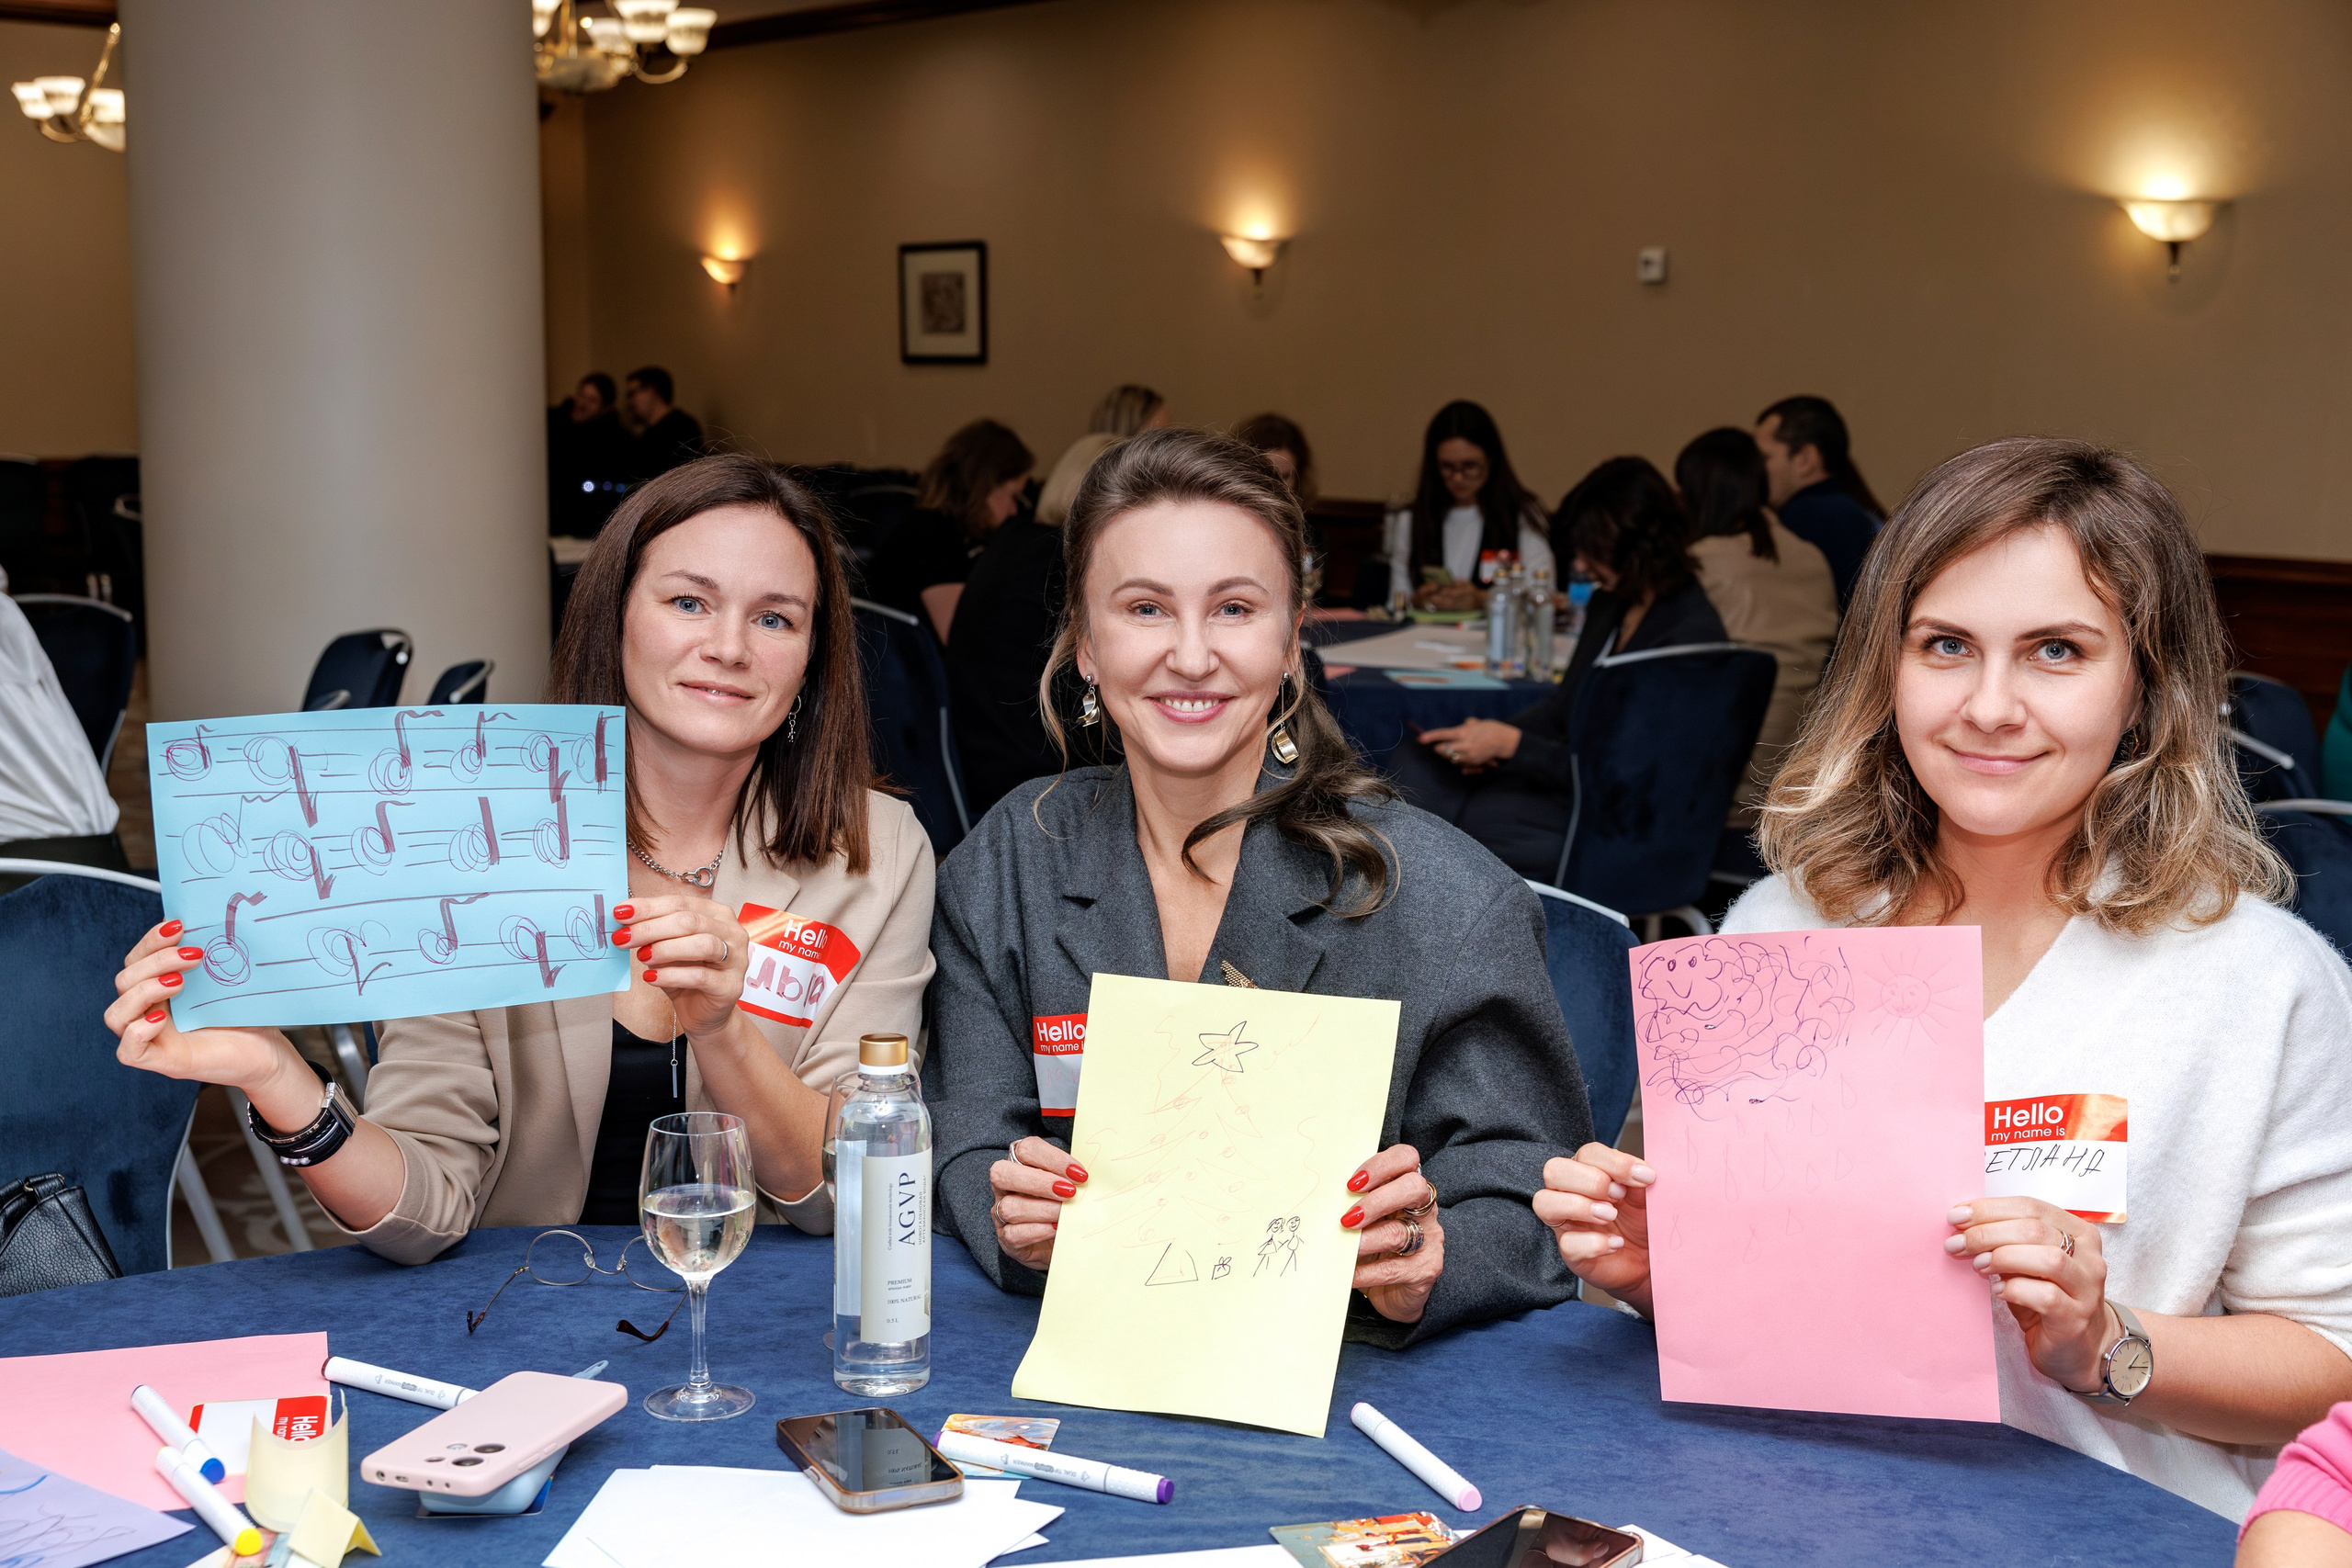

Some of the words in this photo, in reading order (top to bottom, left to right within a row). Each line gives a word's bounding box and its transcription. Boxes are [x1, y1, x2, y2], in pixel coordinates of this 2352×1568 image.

[784, 919, 828, 949] Hello
[778, 941, 797, 953] my
[1036, 1021, 1086, 1042] Hello
[1040, 1044, 1050, 1054] my
[1052, 1043, 1079, 1052] name
[1994, 1102, 2064, 1129] Hello
[1991, 1132, 2010, 1142] my
[2014, 1128, 2052, 1139] name
[2056, 1126, 2065, 1136] is
[899, 1172, 915, 1246] AGVP
[900, 1294, 922, 1303] NATURAL
[276, 1416, 288, 1425] my
[289, 1416, 319, 1441] Hello
[1012, 1459, 1034, 1468] MARKER
